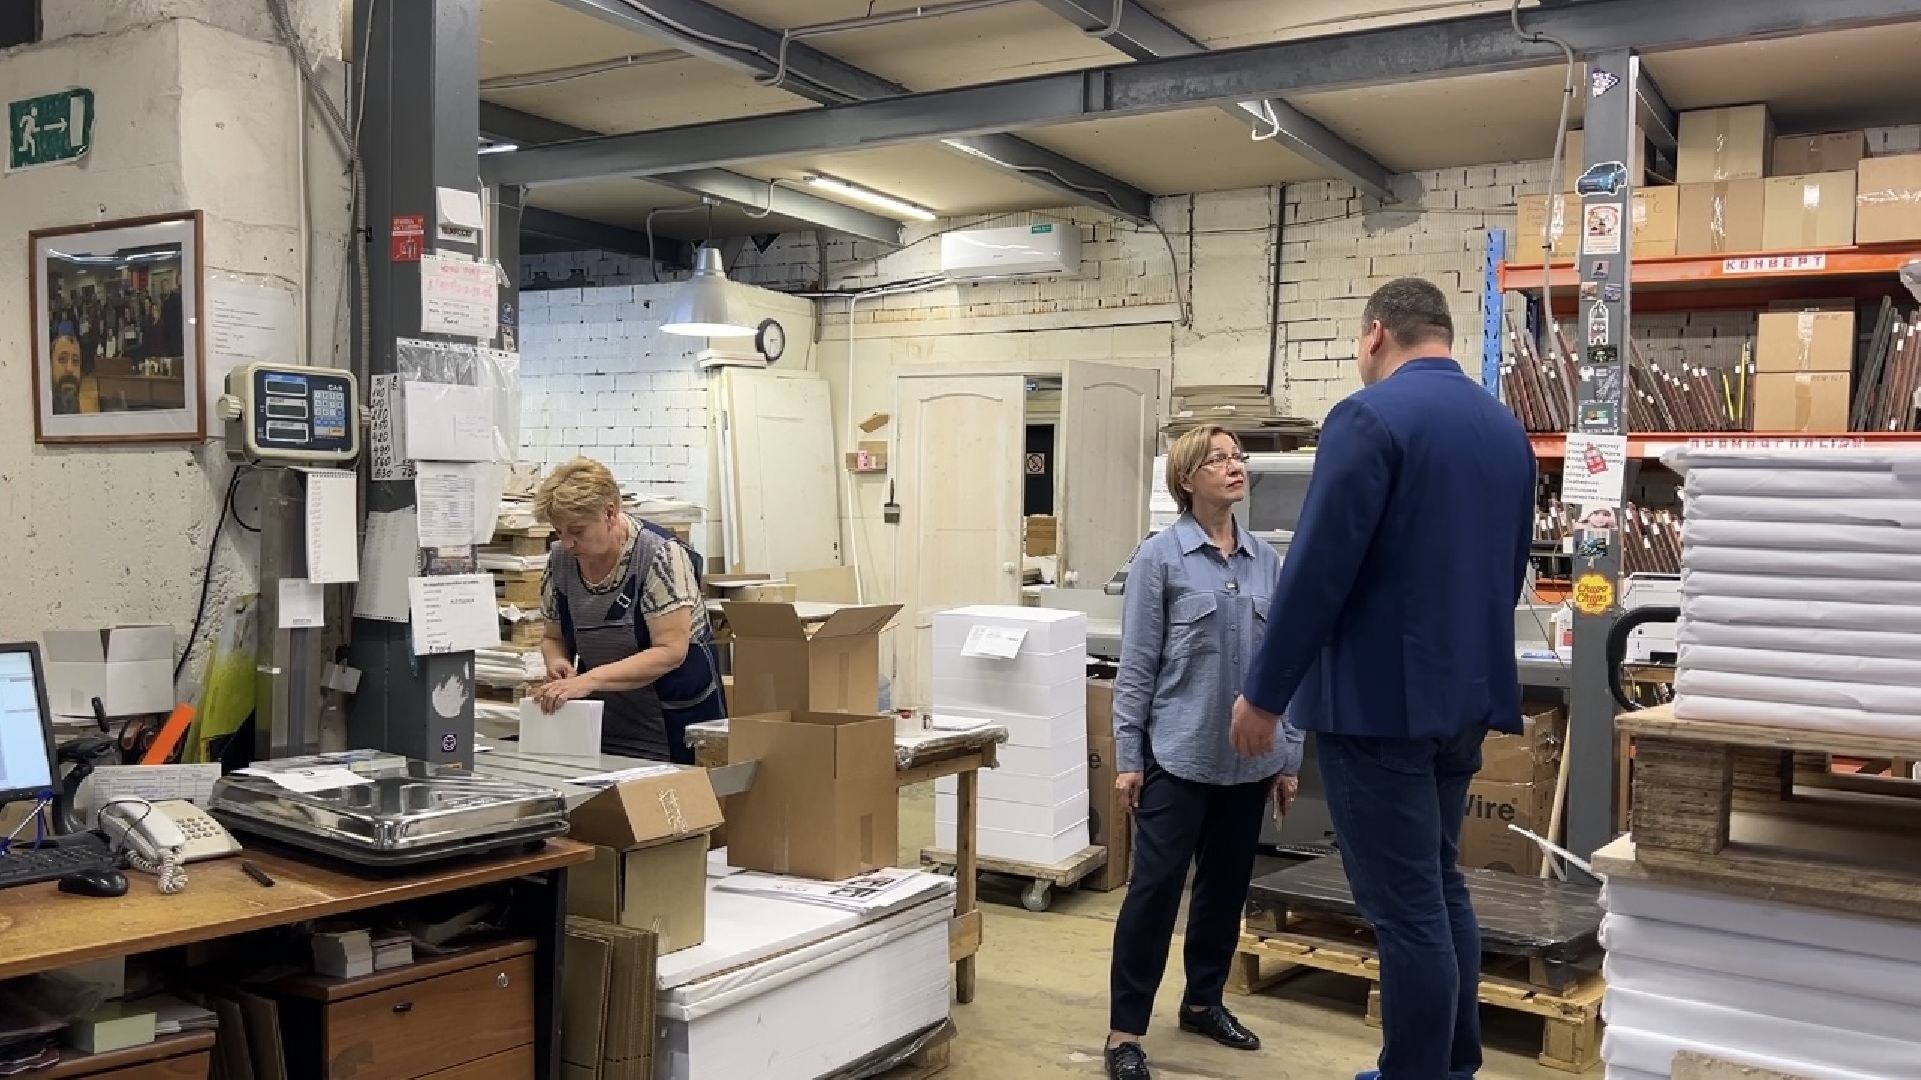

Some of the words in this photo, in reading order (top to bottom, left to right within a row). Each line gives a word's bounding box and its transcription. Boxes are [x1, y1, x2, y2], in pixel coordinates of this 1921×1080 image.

[1726, 256, 1822, 270] КОНВЕРТ
[1578, 583, 1608, 593] Chupa
[1576, 592, 1606, 607] Chups
[1465, 794, 1515, 821] ire
